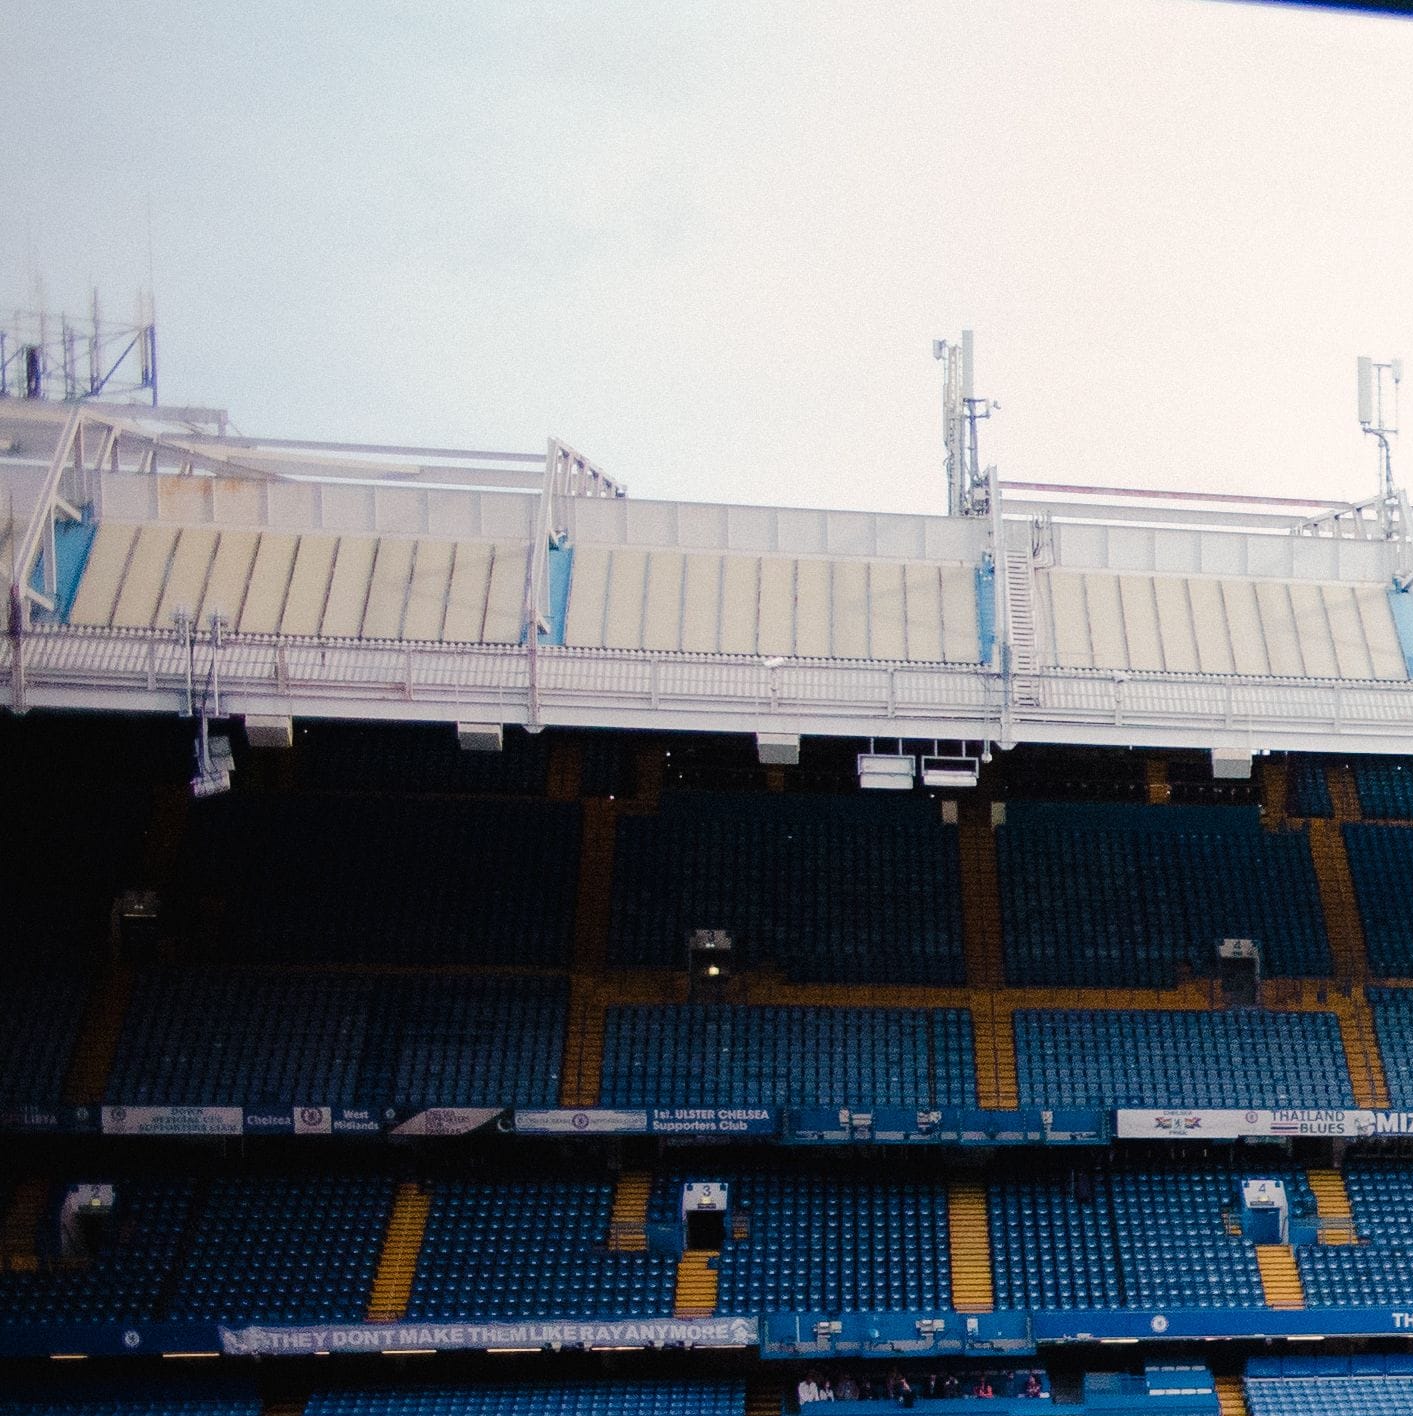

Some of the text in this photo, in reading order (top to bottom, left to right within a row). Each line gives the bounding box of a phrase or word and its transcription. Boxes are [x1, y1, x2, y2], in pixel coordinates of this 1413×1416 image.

[247, 1115, 291, 1125] Chelsea
[343, 1110, 369, 1119] West
[676, 1110, 715, 1120] ULSTER
[717, 1110, 769, 1120] CHELSEA
[1271, 1110, 1345, 1122] THAILAND
[334, 1120, 379, 1130] Midlands
[652, 1121, 715, 1132] Supporters
[719, 1120, 748, 1130] Club
[1300, 1122, 1345, 1134] BLUES
[703, 1185, 712, 1197] 3
[1258, 1184, 1266, 1194] 4
[268, 1332, 328, 1349] THEY
[400, 1328, 464, 1345] MAKE
[468, 1327, 528, 1343] THEM
[530, 1326, 577, 1342] LIKE
[579, 1325, 624, 1341] RAY
[624, 1323, 729, 1341] ANYMORE
